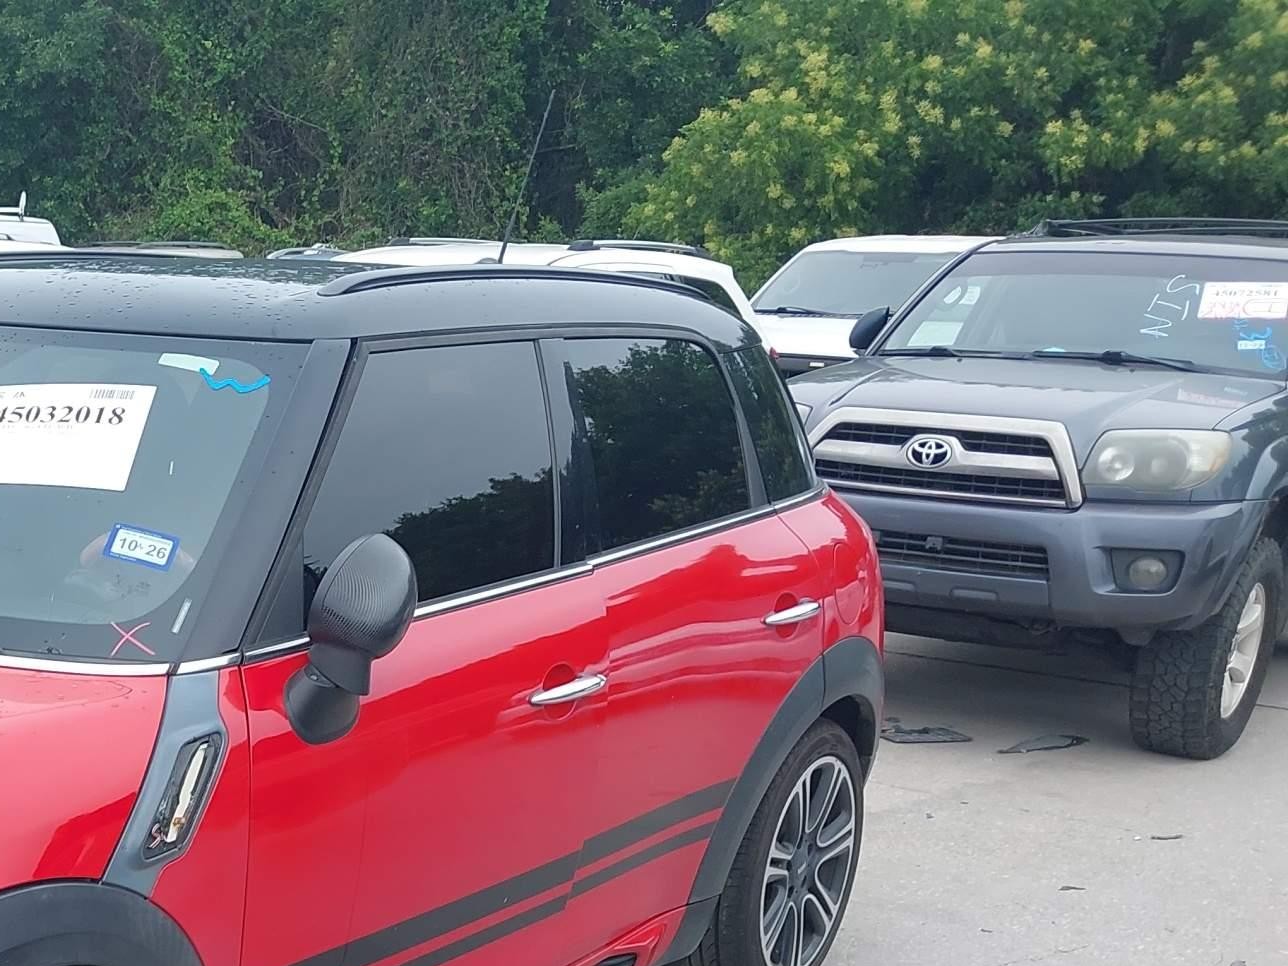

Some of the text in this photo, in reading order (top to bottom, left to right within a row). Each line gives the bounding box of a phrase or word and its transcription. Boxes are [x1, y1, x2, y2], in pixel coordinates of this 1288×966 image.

[1139, 274, 1200, 338] NIS
[119, 537, 139, 552] 10
[144, 543, 168, 560] 26
